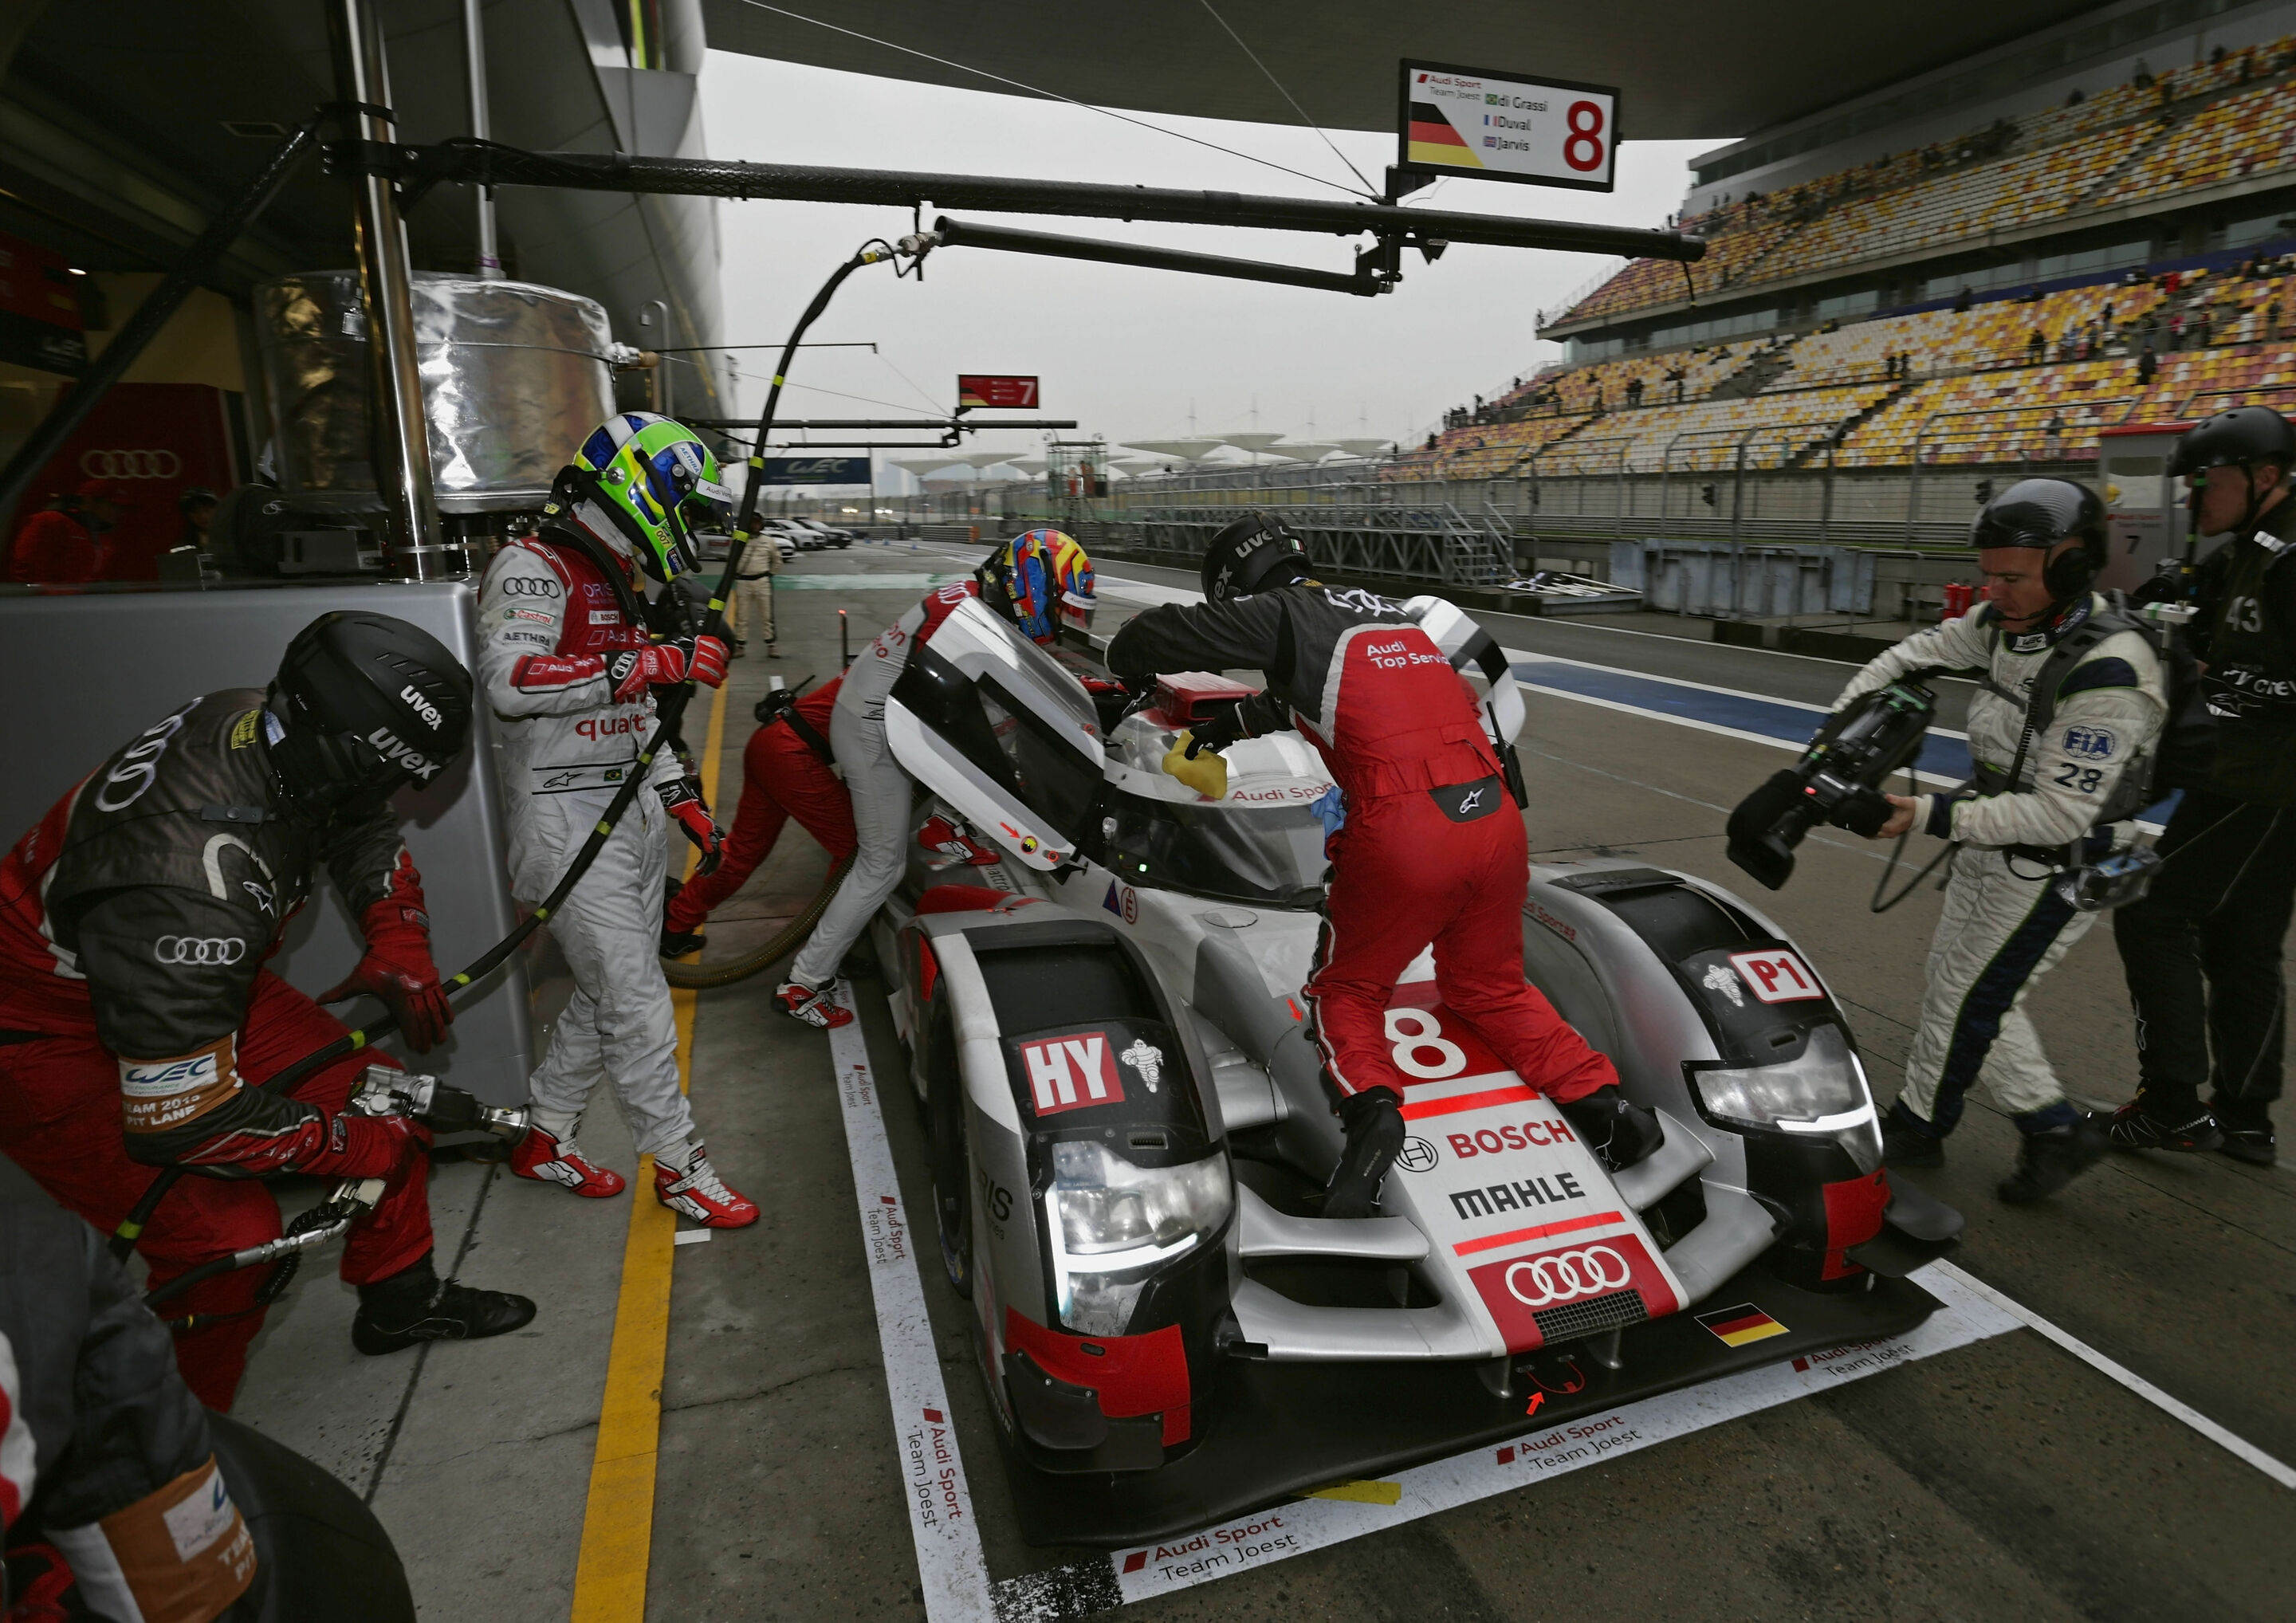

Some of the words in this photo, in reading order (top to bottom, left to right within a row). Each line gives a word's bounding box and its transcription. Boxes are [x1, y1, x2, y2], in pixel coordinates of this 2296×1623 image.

[1429, 75, 1452, 85] Audi
[1454, 77, 1483, 89] Sport
[1429, 86, 1456, 97] Team
[1457, 88, 1480, 100] Joest
[1499, 95, 1511, 107] di
[1512, 96, 1548, 112] Grassi
[1498, 116, 1531, 132] Duval
[1563, 100, 1604, 172] 8
[1496, 136, 1530, 152] Jarvis
[1018, 381, 1036, 405] 7
[680, 446, 700, 474] AETHRA
[787, 458, 850, 474] WEC
[706, 485, 721, 495] Audi
[656, 530, 670, 545] 007
[2125, 535, 2141, 555] 7
[517, 609, 554, 625] Castrol
[600, 612, 619, 621] BOSCH
[2225, 595, 2262, 633] 43
[504, 631, 550, 646] AETHRA
[1366, 640, 1407, 657] Audi
[1370, 656, 1407, 669] Top
[400, 685, 444, 732] uvex
[576, 714, 647, 741] quat
[368, 726, 441, 780] uvex
[2054, 762, 2102, 794] 28
[1232, 789, 1285, 802] Audi
[986, 865, 1010, 892] uattro
[1746, 957, 1808, 993] P1
[1384, 1008, 1468, 1079] 8
[125, 1055, 214, 1083] WEC
[843, 1073, 855, 1091] Team
[857, 1072, 871, 1086] Audi
[1025, 1037, 1107, 1110] HY
[843, 1091, 857, 1109] Joest
[859, 1086, 872, 1106] Sport
[127, 1116, 146, 1126] PIT
[1447, 1119, 1576, 1159] BOSCH
[1449, 1172, 1586, 1220] MAHLE
[868, 1209, 880, 1236] Team
[887, 1207, 898, 1229] Audi
[872, 1236, 887, 1264] Joest
[890, 1229, 906, 1260] Sport
[1811, 1344, 1850, 1364] Audi
[1822, 1358, 1869, 1377] Team
[1871, 1342, 1917, 1365] Joest
[930, 1428, 952, 1464] Audi
[1520, 1432, 1567, 1455] Audi
[1567, 1415, 1625, 1440] Sport
[908, 1429, 926, 1476] Team
[1528, 1446, 1590, 1471] Team
[1588, 1429, 1642, 1454] Joest
[914, 1480, 938, 1528] Joest
[938, 1468, 962, 1520] Sport
[1154, 1535, 1211, 1562] Audi
[1214, 1516, 1284, 1545] Sport
[1158, 1554, 1229, 1582] Team
[1233, 1534, 1298, 1563] Joest
